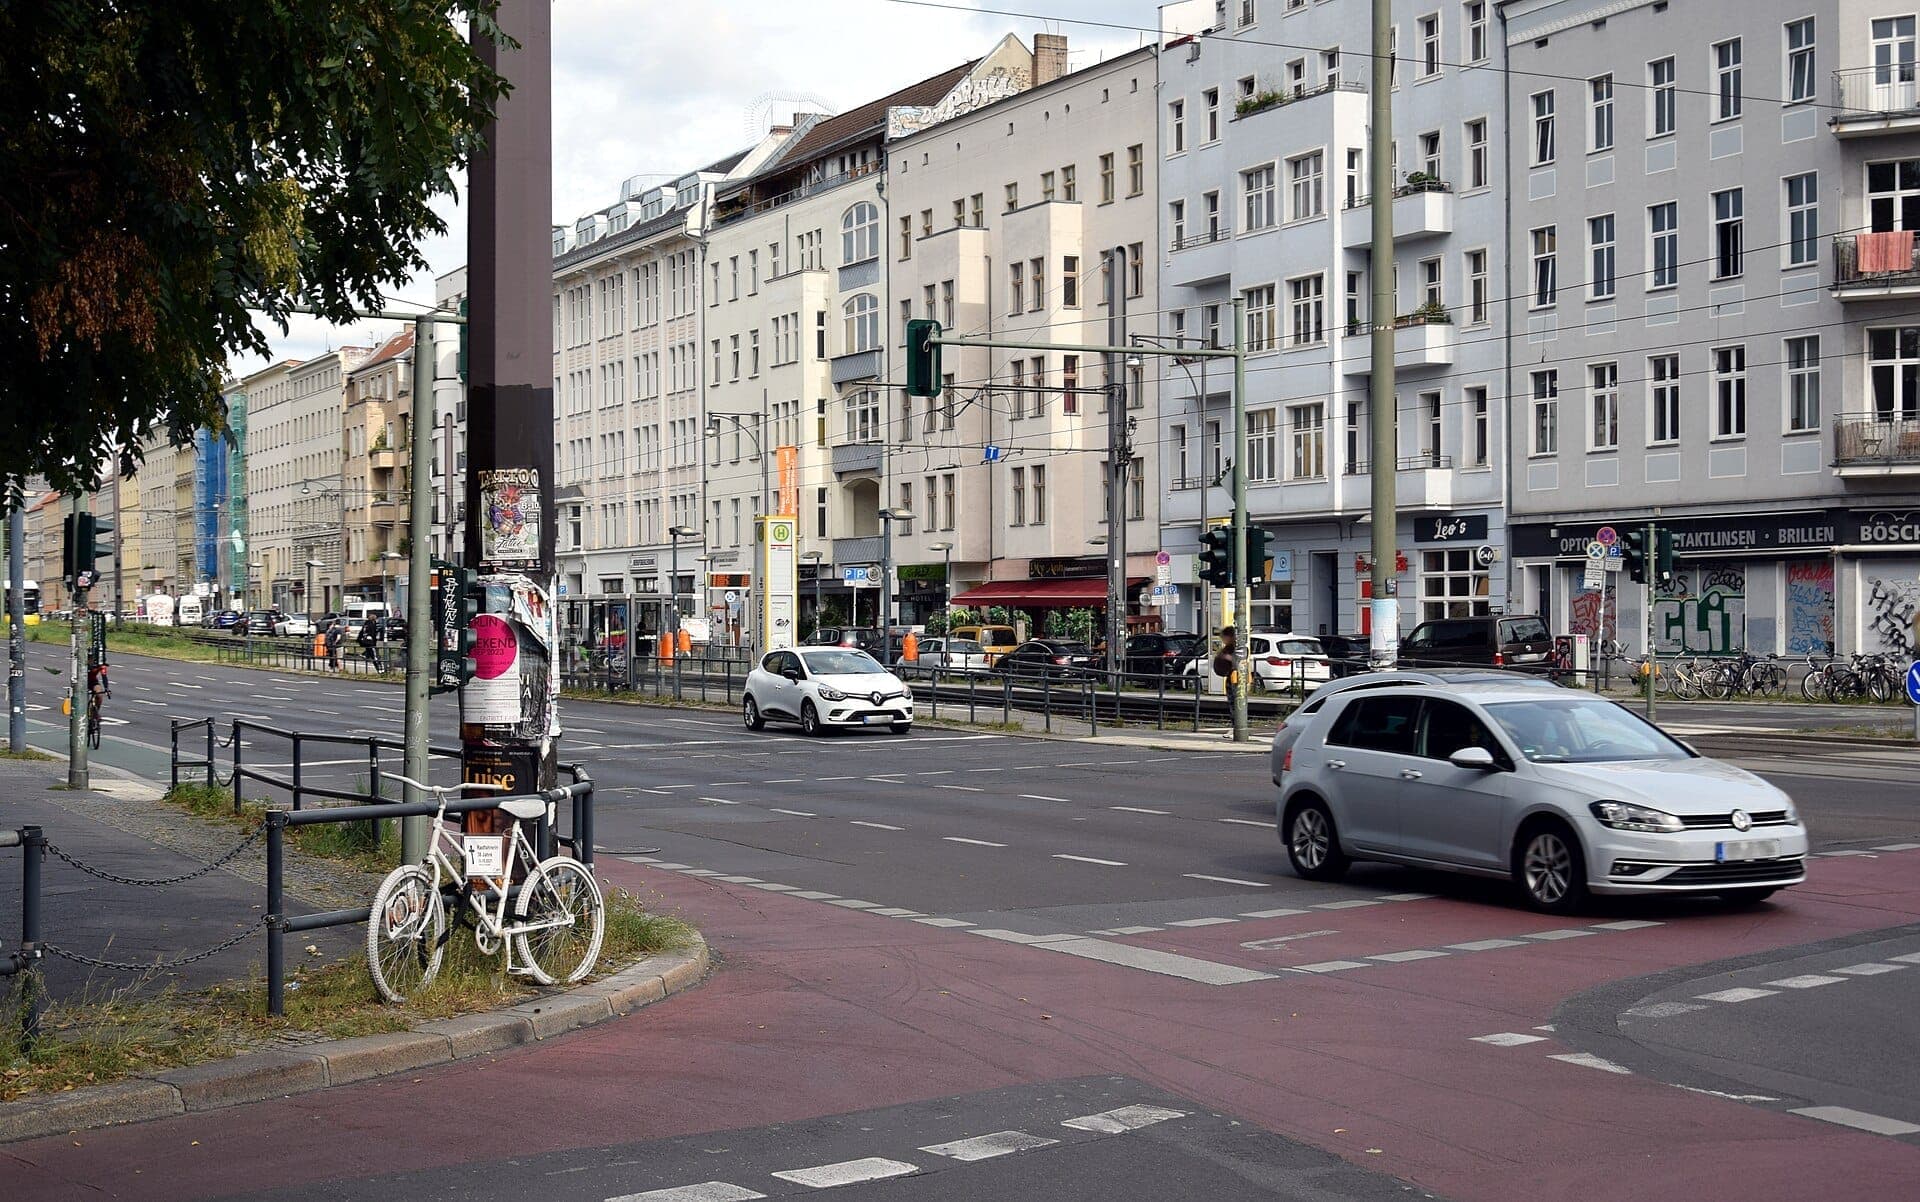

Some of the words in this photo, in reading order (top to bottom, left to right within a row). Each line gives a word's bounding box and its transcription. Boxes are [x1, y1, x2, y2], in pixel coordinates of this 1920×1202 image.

[478, 468, 539, 489] TATTOO
[776, 529, 785, 539] H
[1672, 530, 1756, 548] TAKTLINSEN
[1778, 526, 1834, 544] BRILLEN
[476, 638, 517, 649] EKEND
